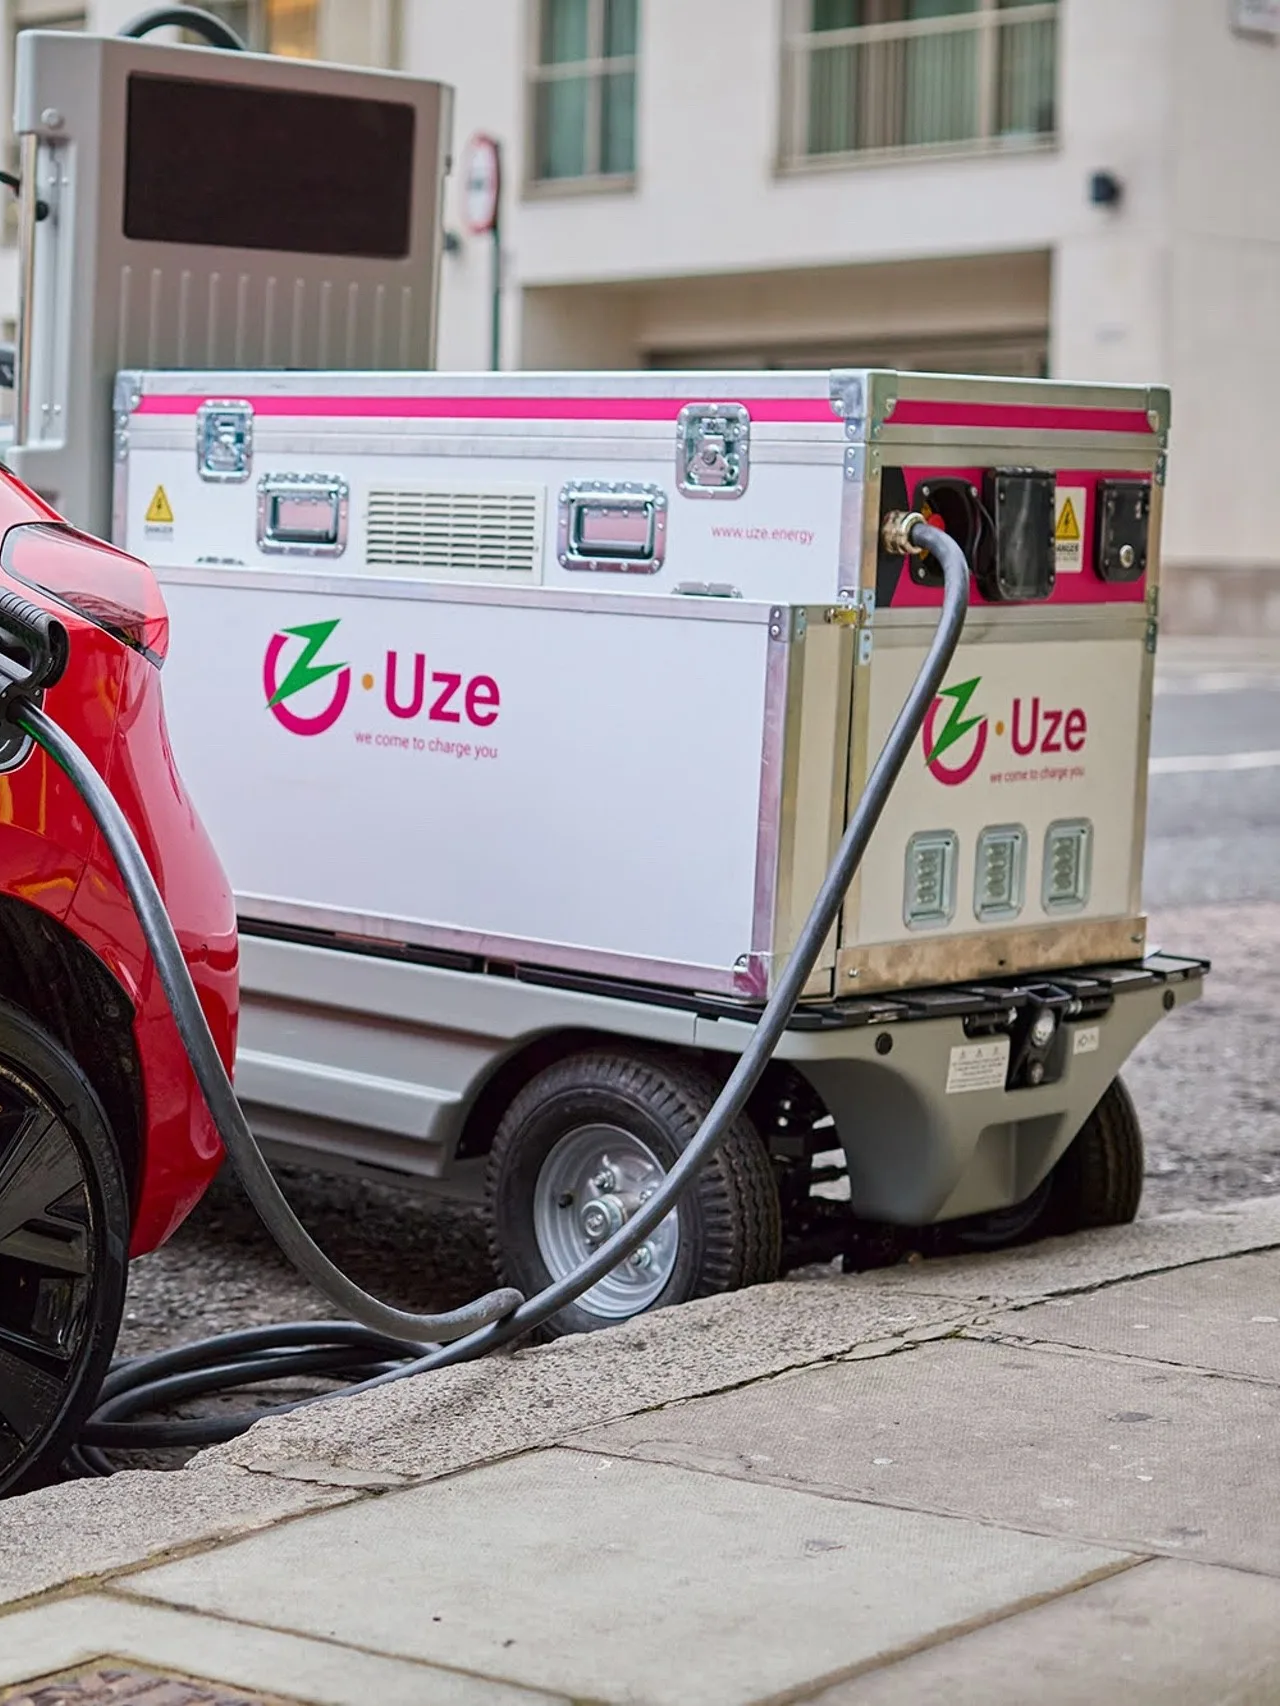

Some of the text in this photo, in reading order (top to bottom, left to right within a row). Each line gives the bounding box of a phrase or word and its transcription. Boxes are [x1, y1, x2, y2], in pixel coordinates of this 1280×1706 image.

[710, 526, 814, 544] www.uze.energy
[385, 650, 501, 727] Uze
[354, 731, 499, 760] we come to charge you
[1011, 697, 1087, 756] Uze
